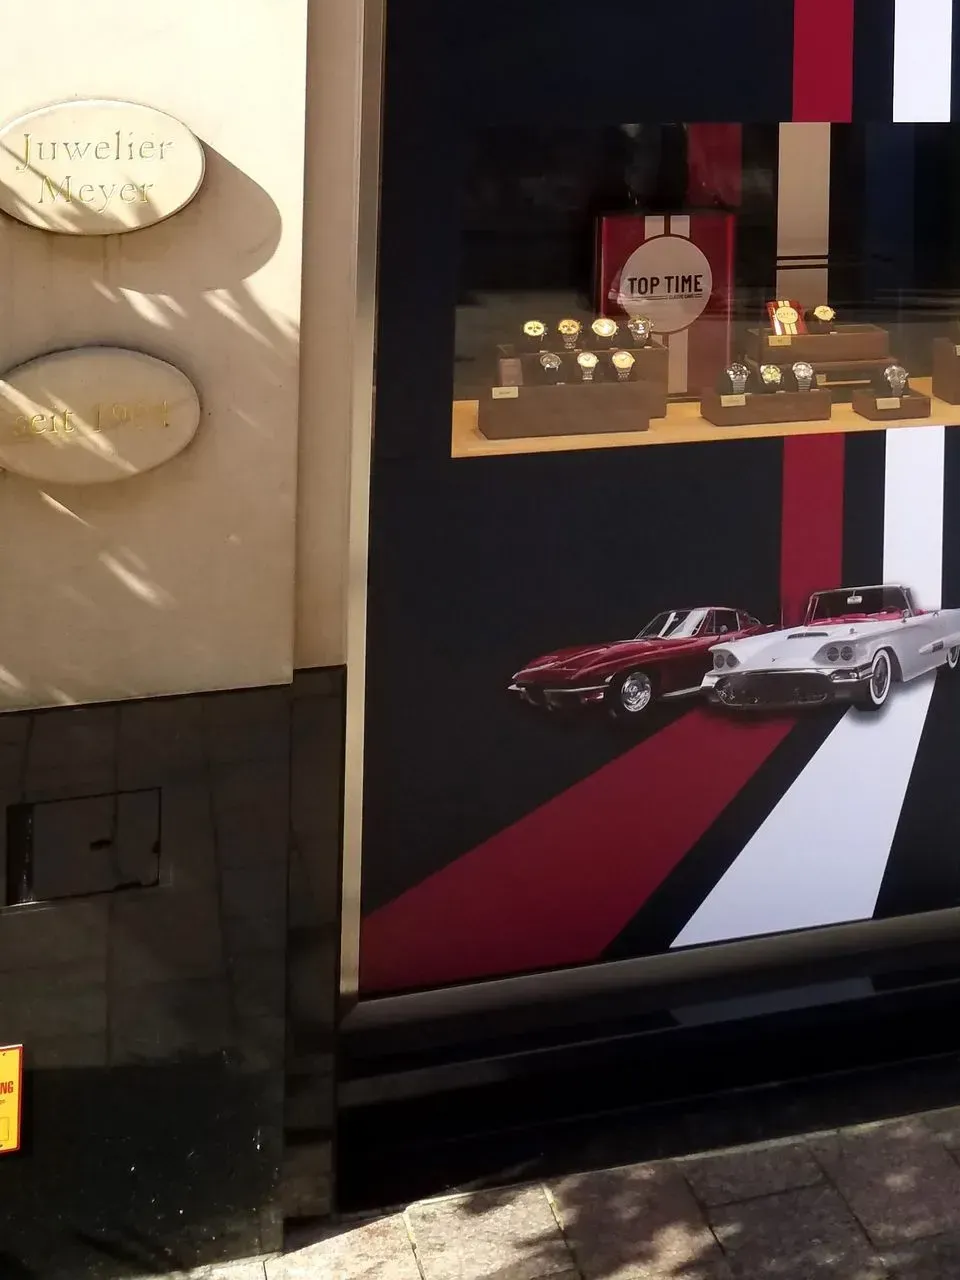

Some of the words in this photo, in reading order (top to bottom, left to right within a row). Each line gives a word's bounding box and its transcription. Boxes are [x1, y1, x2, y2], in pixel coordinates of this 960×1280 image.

[15, 129, 174, 173] Juwelier
[38, 175, 154, 214] Meyer
[627, 276, 660, 295] TOP
[664, 274, 703, 294] TIME
